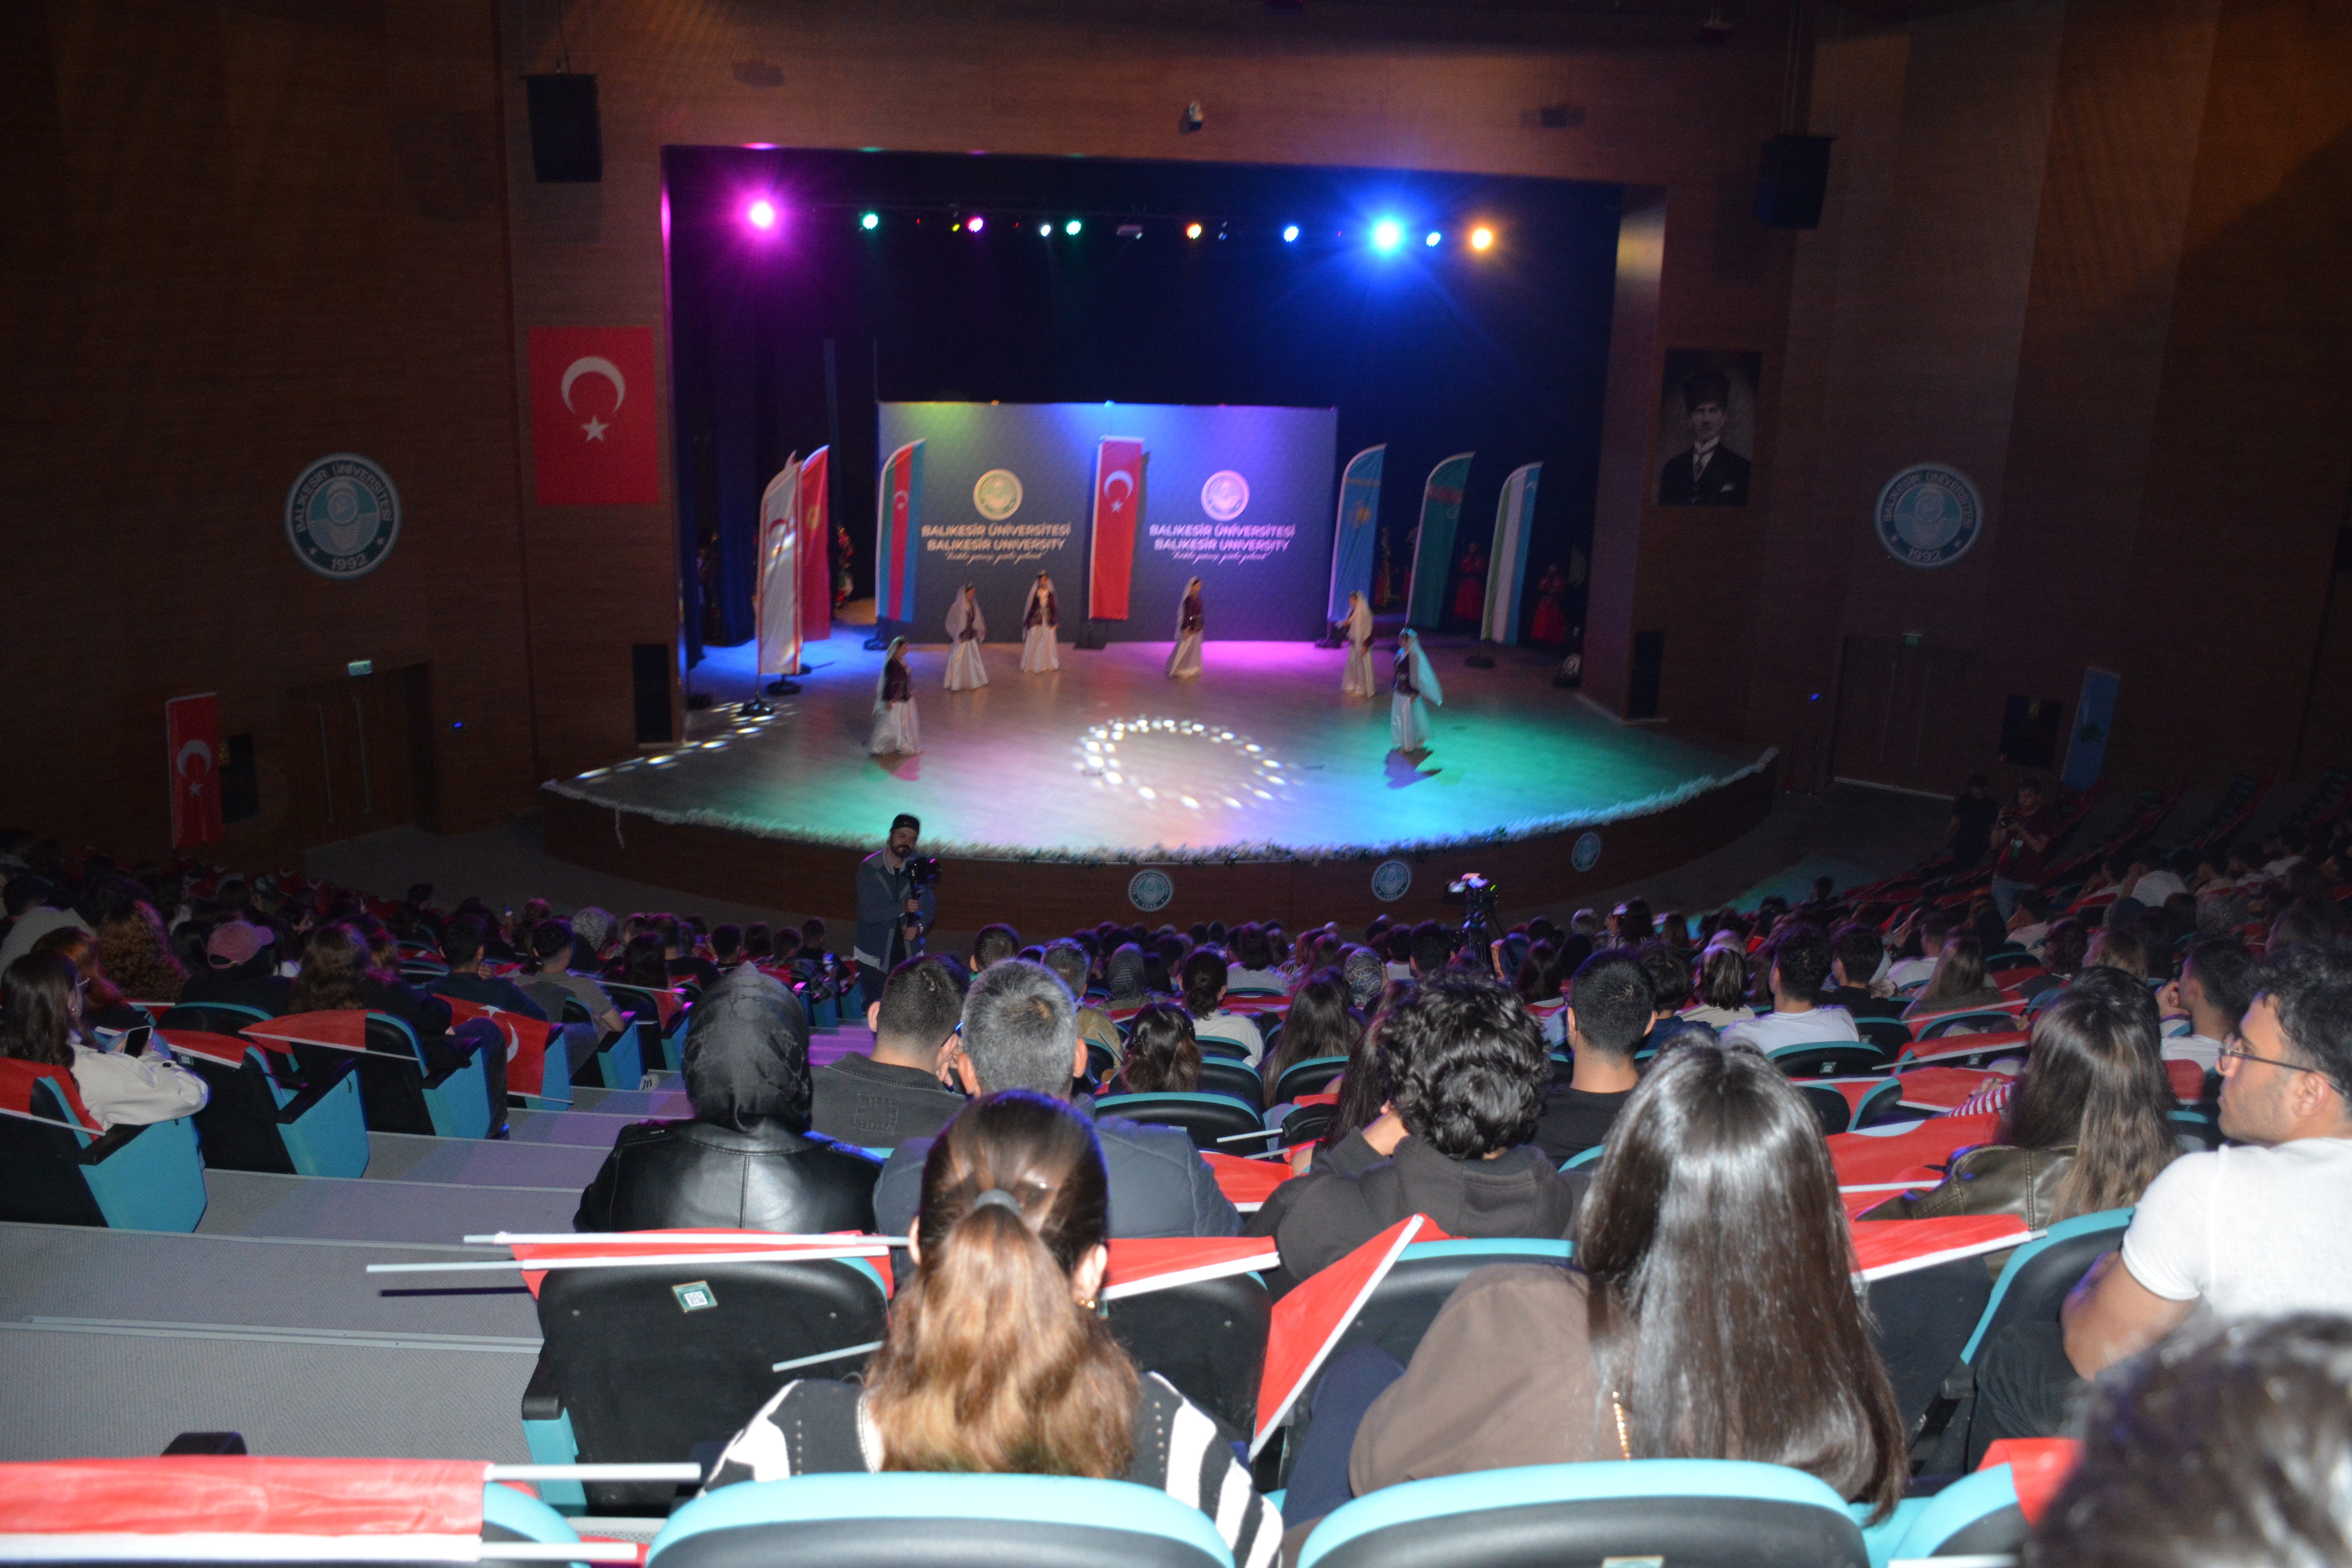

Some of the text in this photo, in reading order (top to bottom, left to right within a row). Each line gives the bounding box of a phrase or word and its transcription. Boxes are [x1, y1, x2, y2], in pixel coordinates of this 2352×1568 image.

[922, 522, 1071, 537] BALIKESİR ÜNİVERSİTESİ
[1149, 523, 1296, 537] BALIKESİR ÜNİVERSİTESİ
[993, 538, 1066, 551] UNIVERSITY
[1219, 539, 1290, 552] UNIVERSITY
[1908, 548, 1942, 561] 1992
[331, 554, 368, 570] 1992
